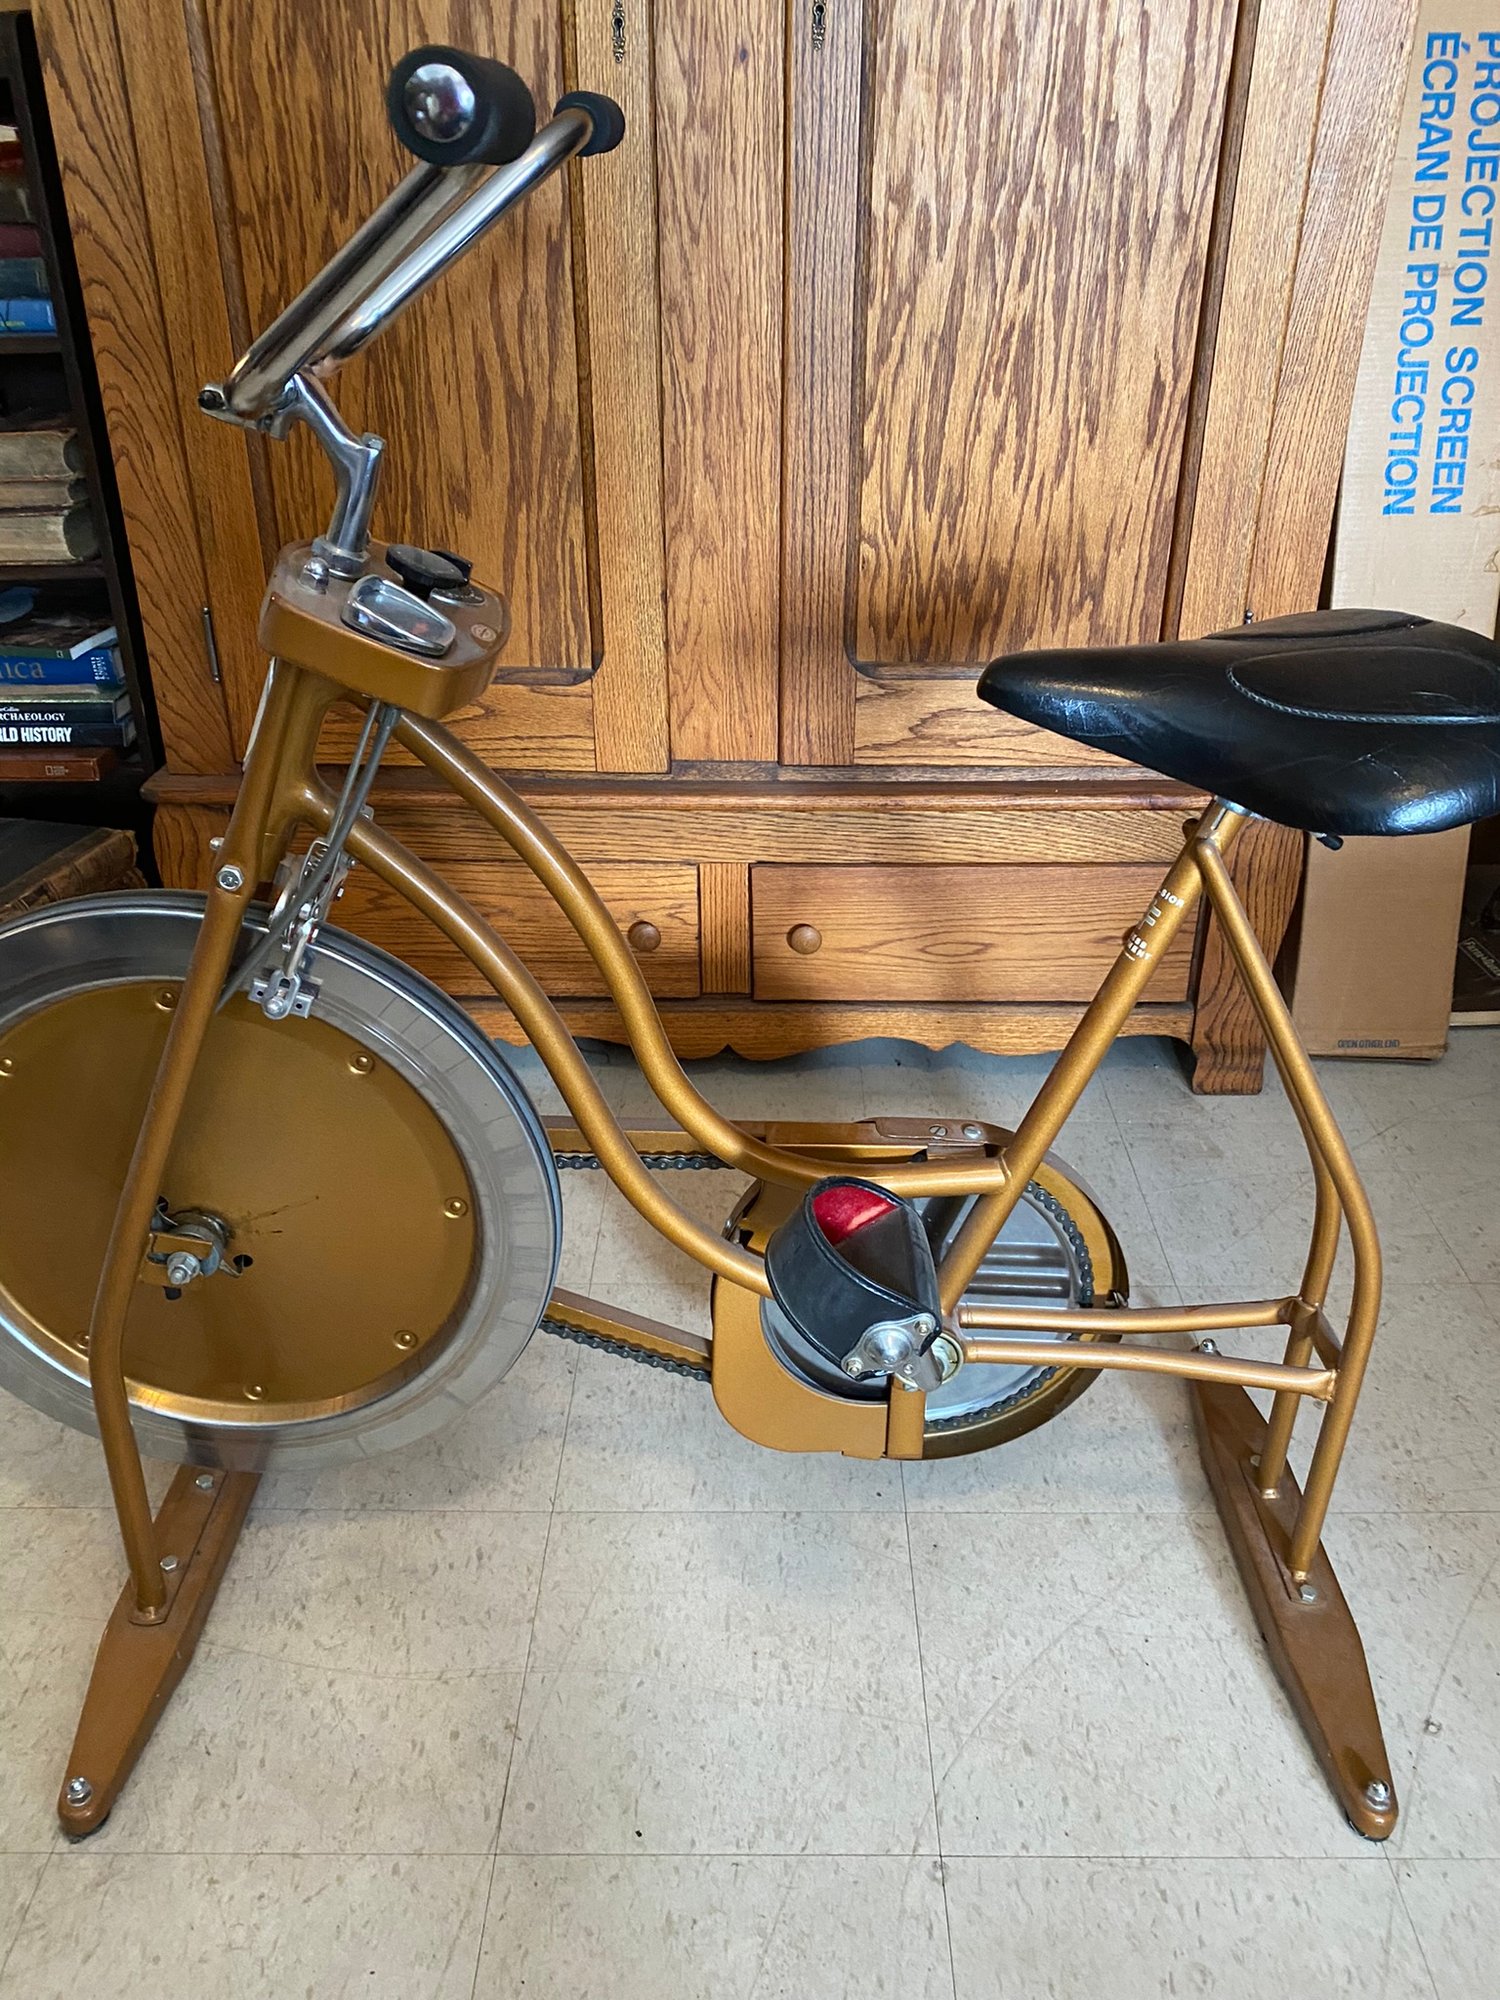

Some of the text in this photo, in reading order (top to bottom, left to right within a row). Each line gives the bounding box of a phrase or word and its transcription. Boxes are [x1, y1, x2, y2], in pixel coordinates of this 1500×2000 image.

[1383, 32, 1471, 515] ÉCRAN DE PROJECTION
[1430, 32, 1500, 513] PROJECTION SCREEN
[20, 727, 72, 742] HISTORY
